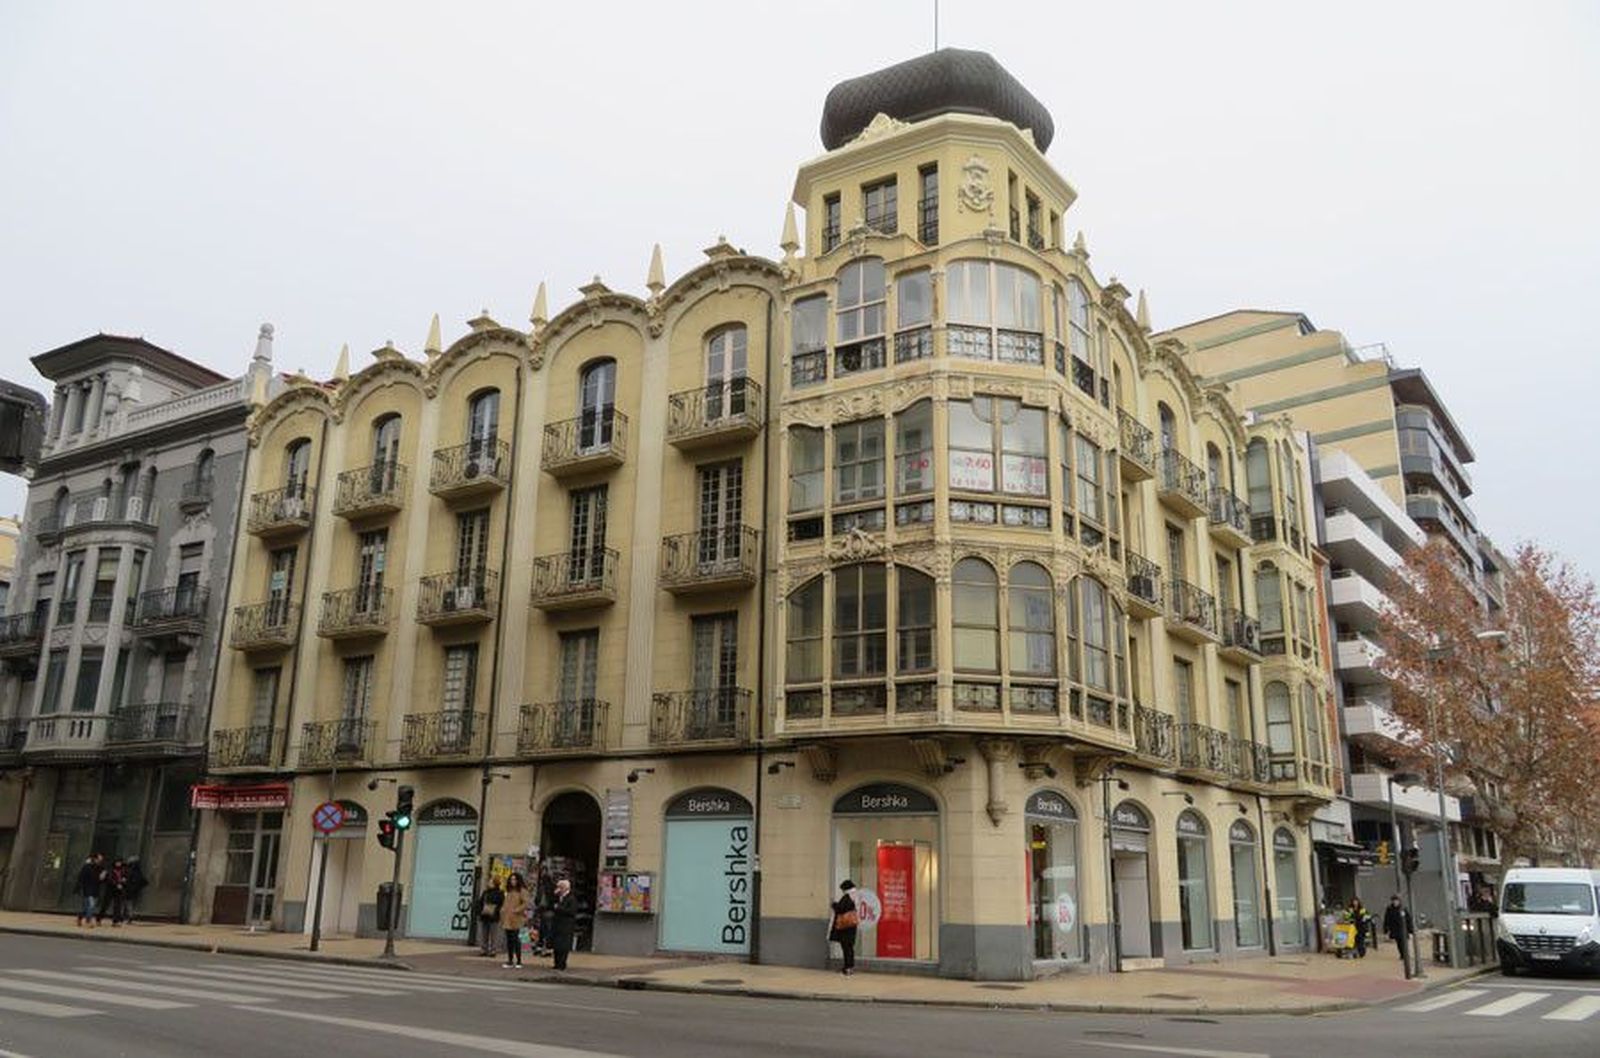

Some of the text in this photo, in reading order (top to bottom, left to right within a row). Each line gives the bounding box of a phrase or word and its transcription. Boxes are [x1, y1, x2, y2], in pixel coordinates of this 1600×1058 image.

[688, 799, 731, 812] Bershka
[861, 794, 908, 808] Bershka
[451, 829, 477, 931] Bershka
[721, 826, 748, 945] Bershka
